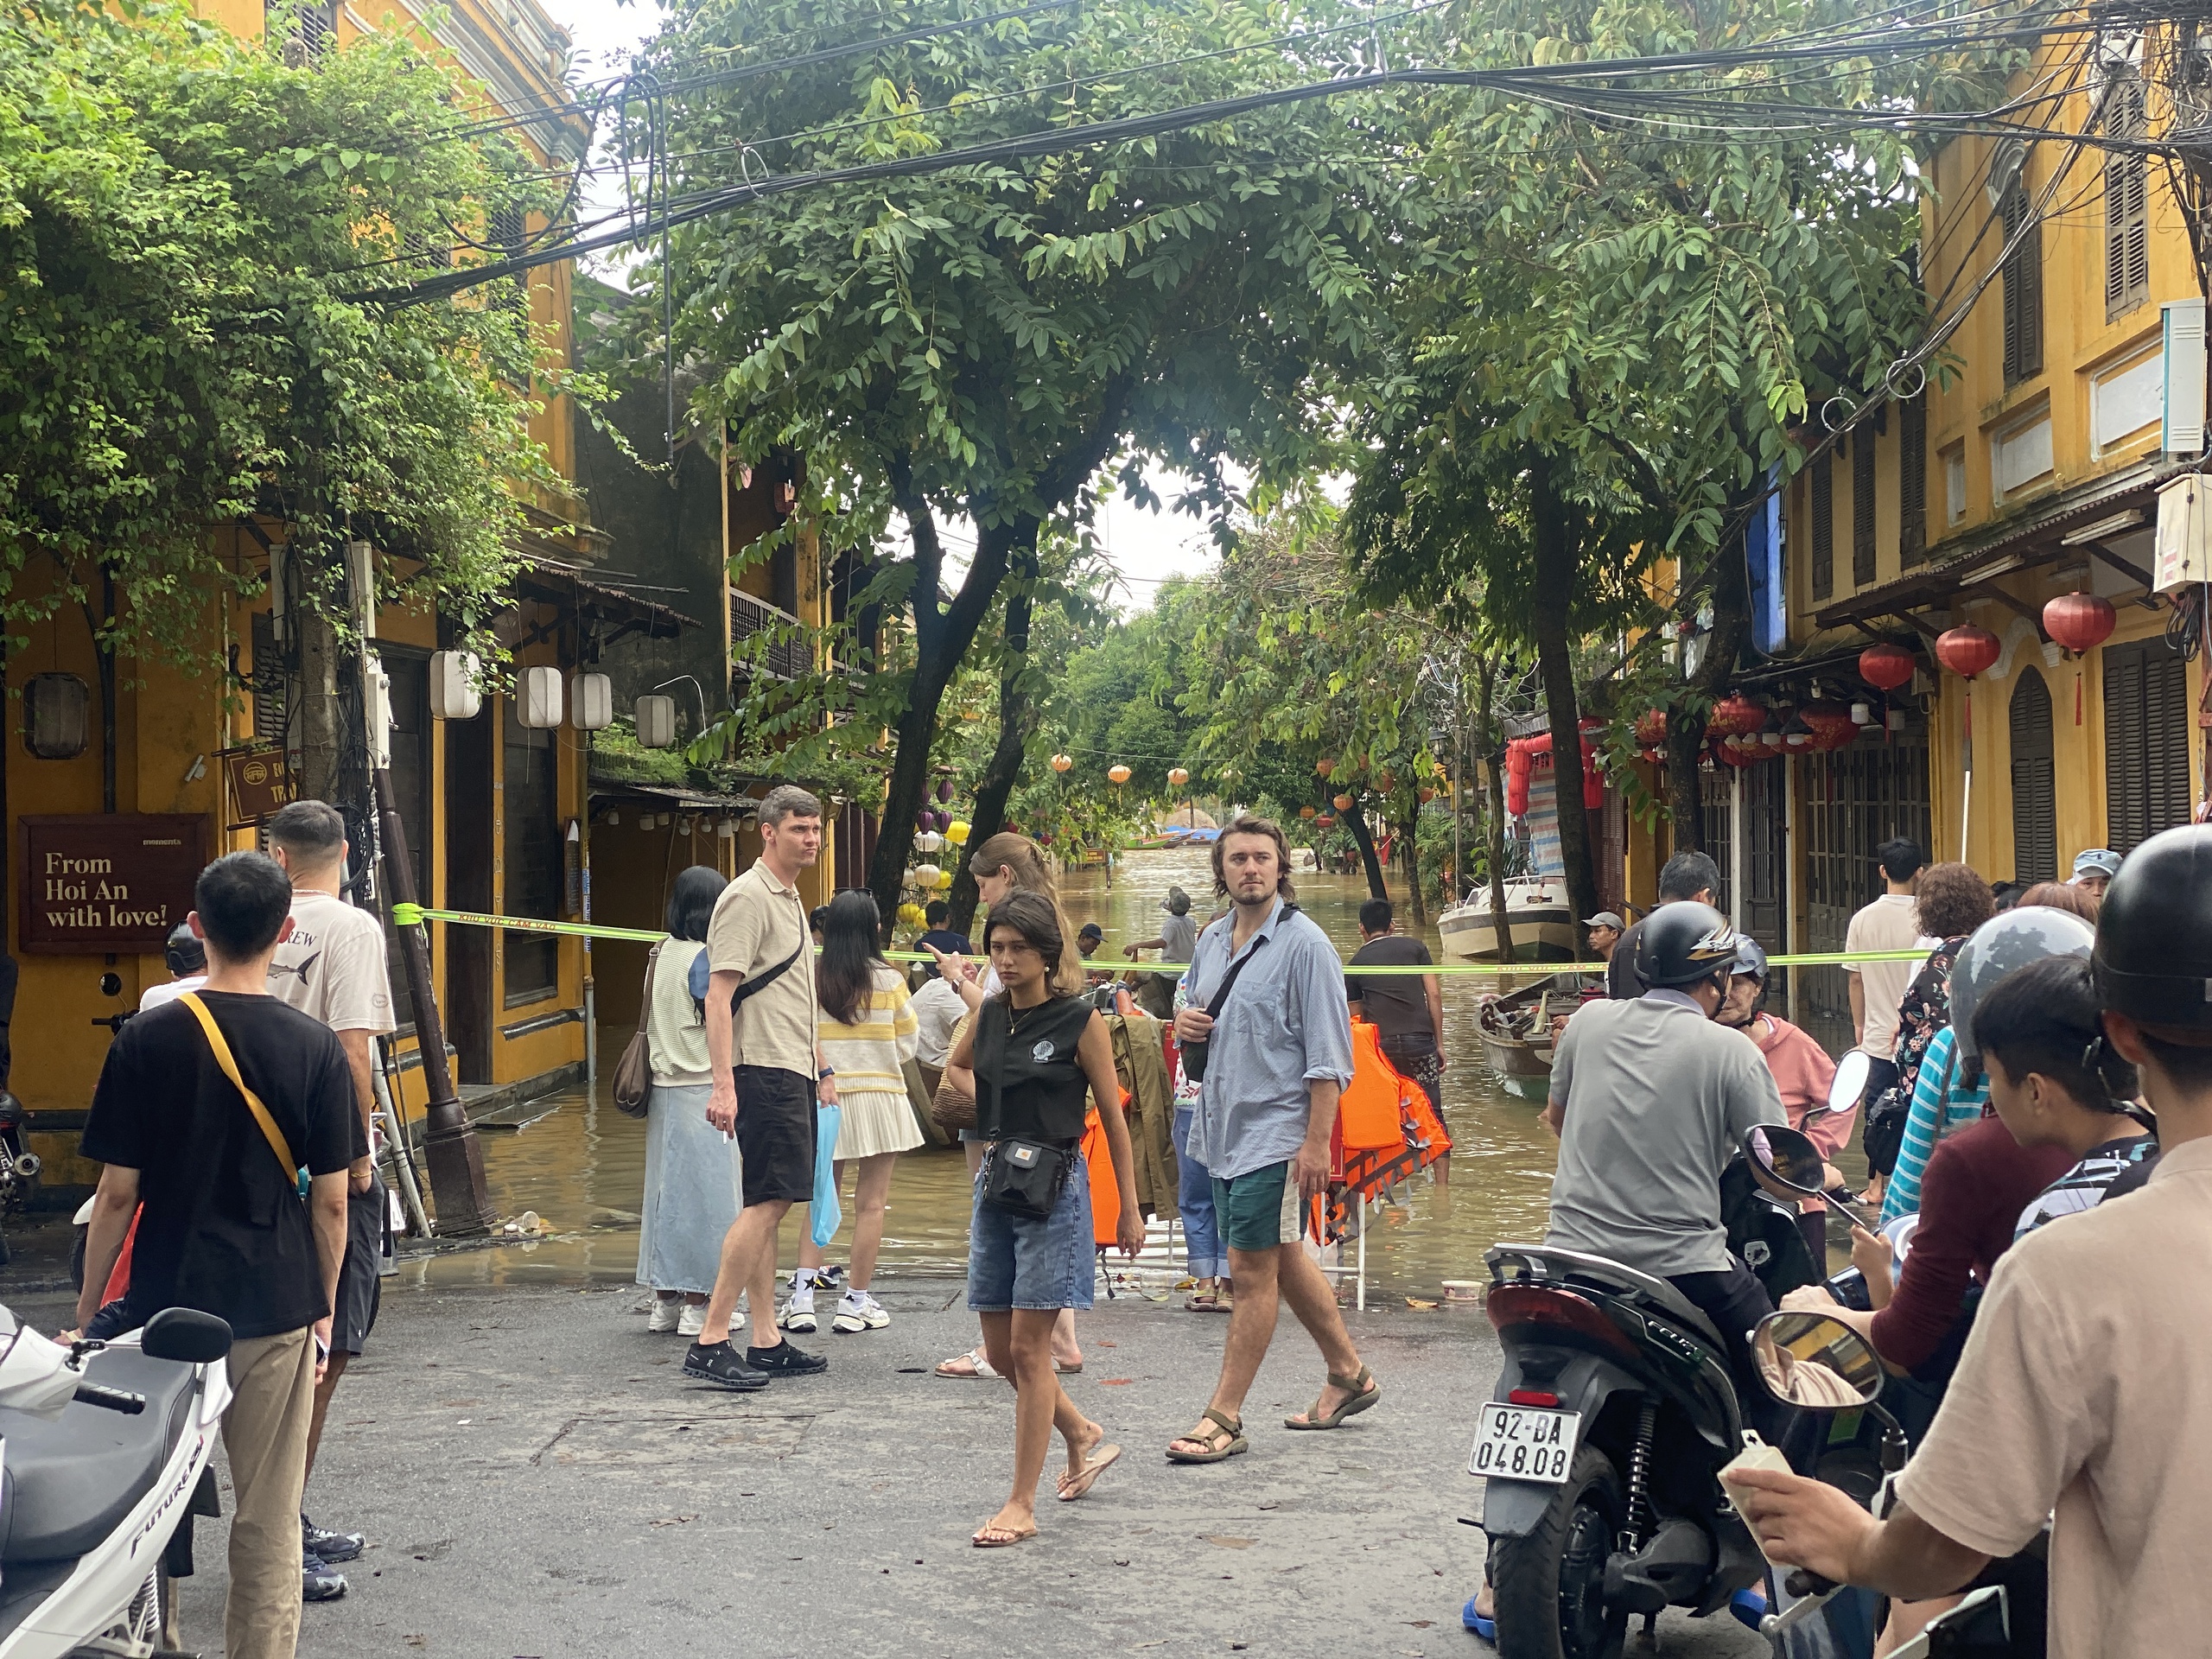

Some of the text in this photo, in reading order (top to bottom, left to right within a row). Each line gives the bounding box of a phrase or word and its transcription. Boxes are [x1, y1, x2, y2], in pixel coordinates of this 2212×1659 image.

[45, 852, 112, 874] From
[45, 879, 129, 900] Hoi An
[45, 904, 168, 927] with love!
[458, 914, 480, 923] KHU
[1492, 1410, 1562, 1446] 92-BA
[1477, 1441, 1567, 1478] 048.08
[130, 1469, 189, 1560] FUTURE
